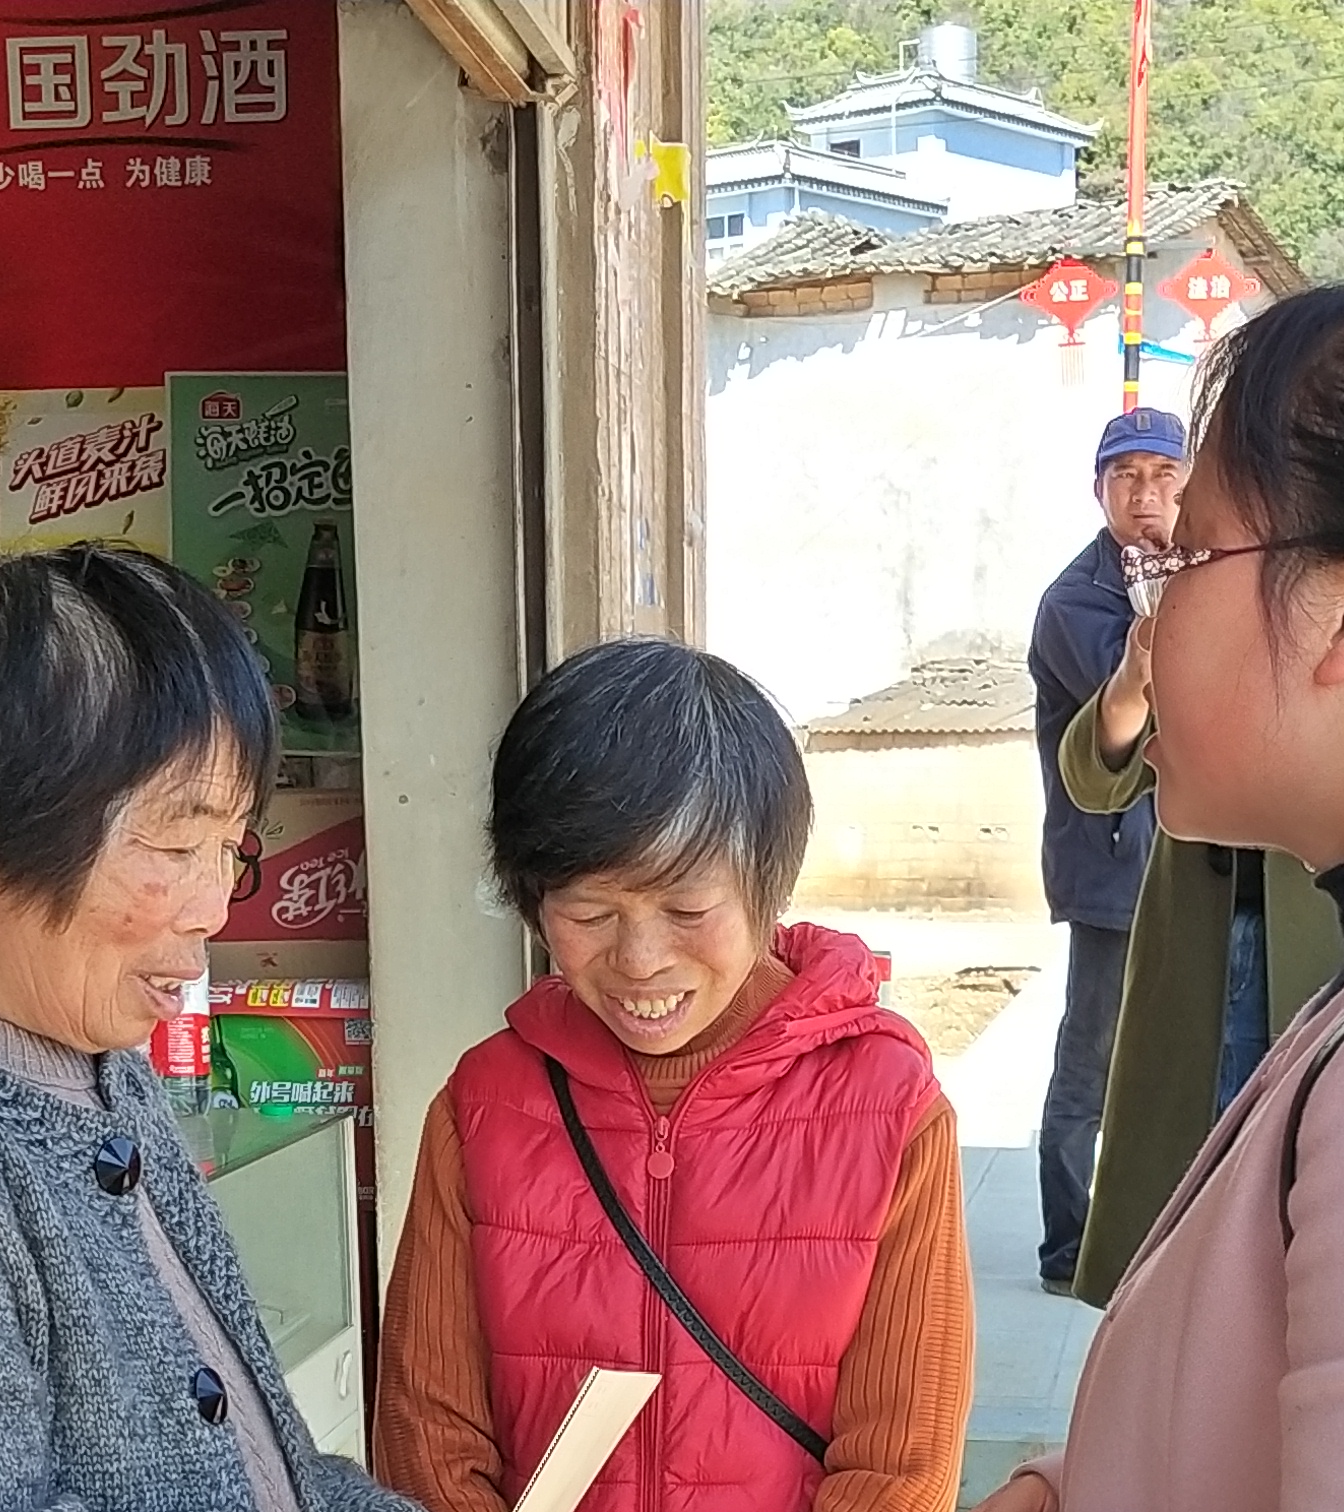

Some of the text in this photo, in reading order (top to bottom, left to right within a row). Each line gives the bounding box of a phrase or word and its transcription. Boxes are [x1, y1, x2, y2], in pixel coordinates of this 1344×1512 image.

[125, 155, 213, 188] 为健康
[1049, 279, 1090, 302] 公正
[1187, 275, 1231, 299] 法治
[205, 401, 238, 417] 海天
[9, 413, 162, 490] 头道麦汁
